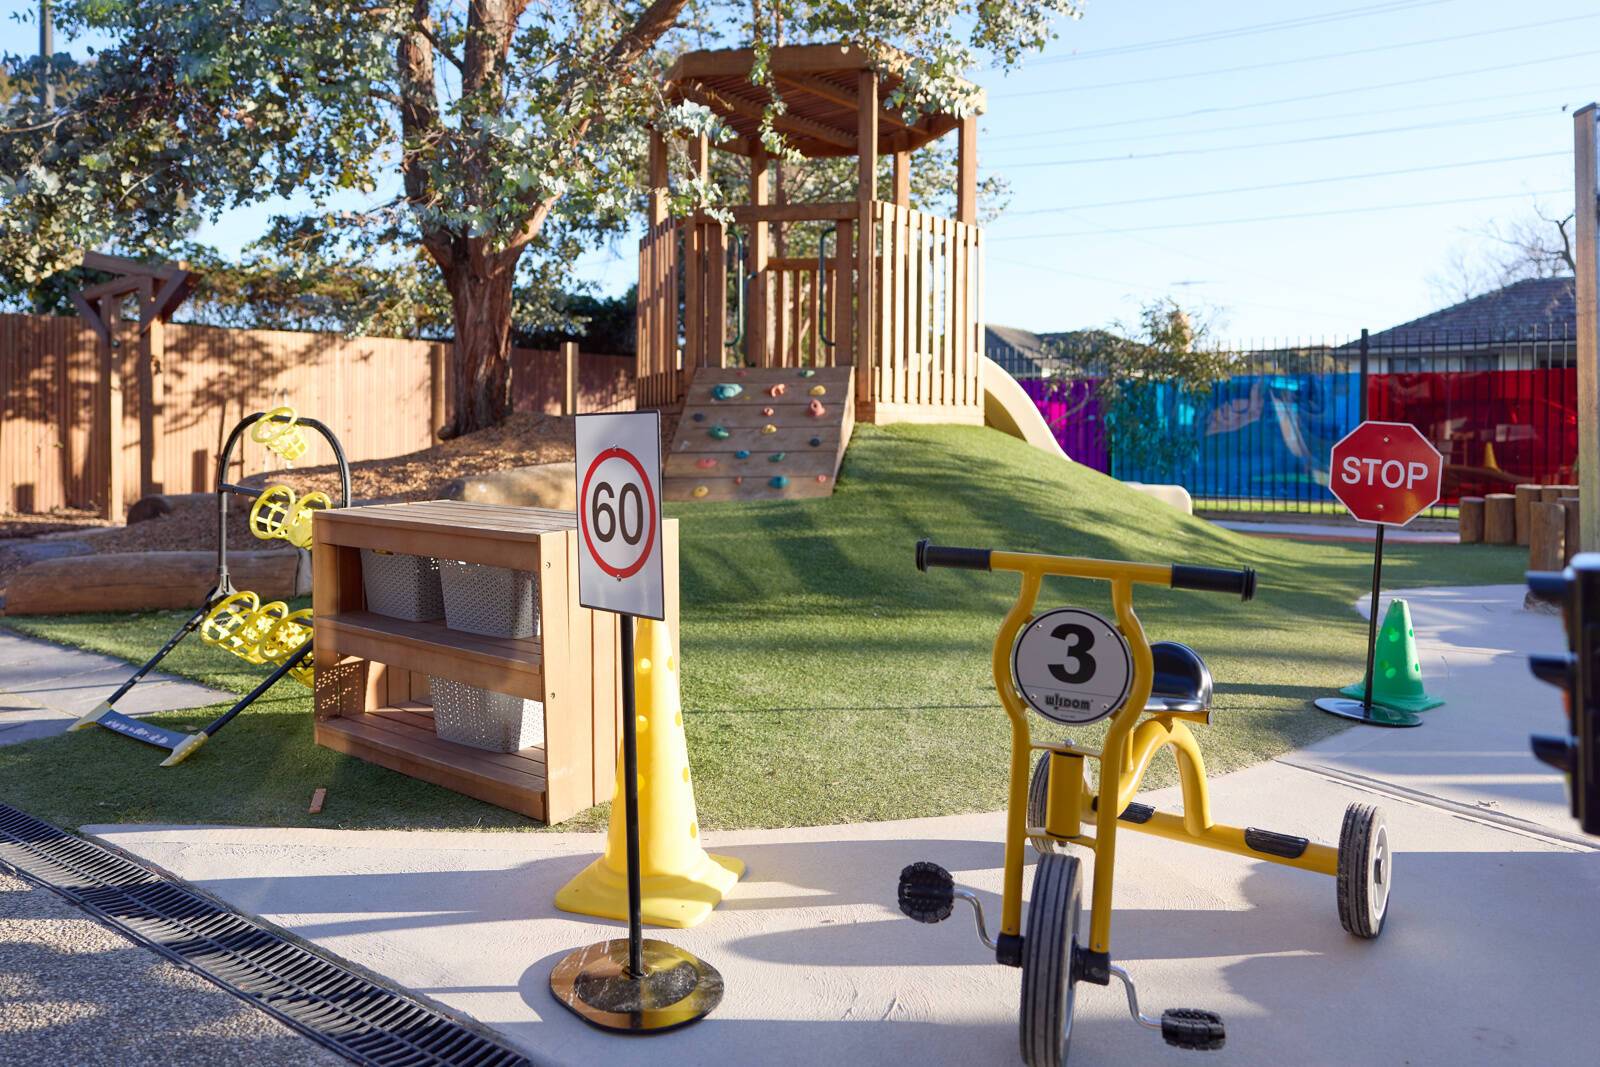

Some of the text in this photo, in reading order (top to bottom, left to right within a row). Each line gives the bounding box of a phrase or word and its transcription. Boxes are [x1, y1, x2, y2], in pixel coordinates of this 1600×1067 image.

[1341, 456, 1428, 490] STOP
[592, 481, 644, 546] 60
[1047, 623, 1097, 684] 3
